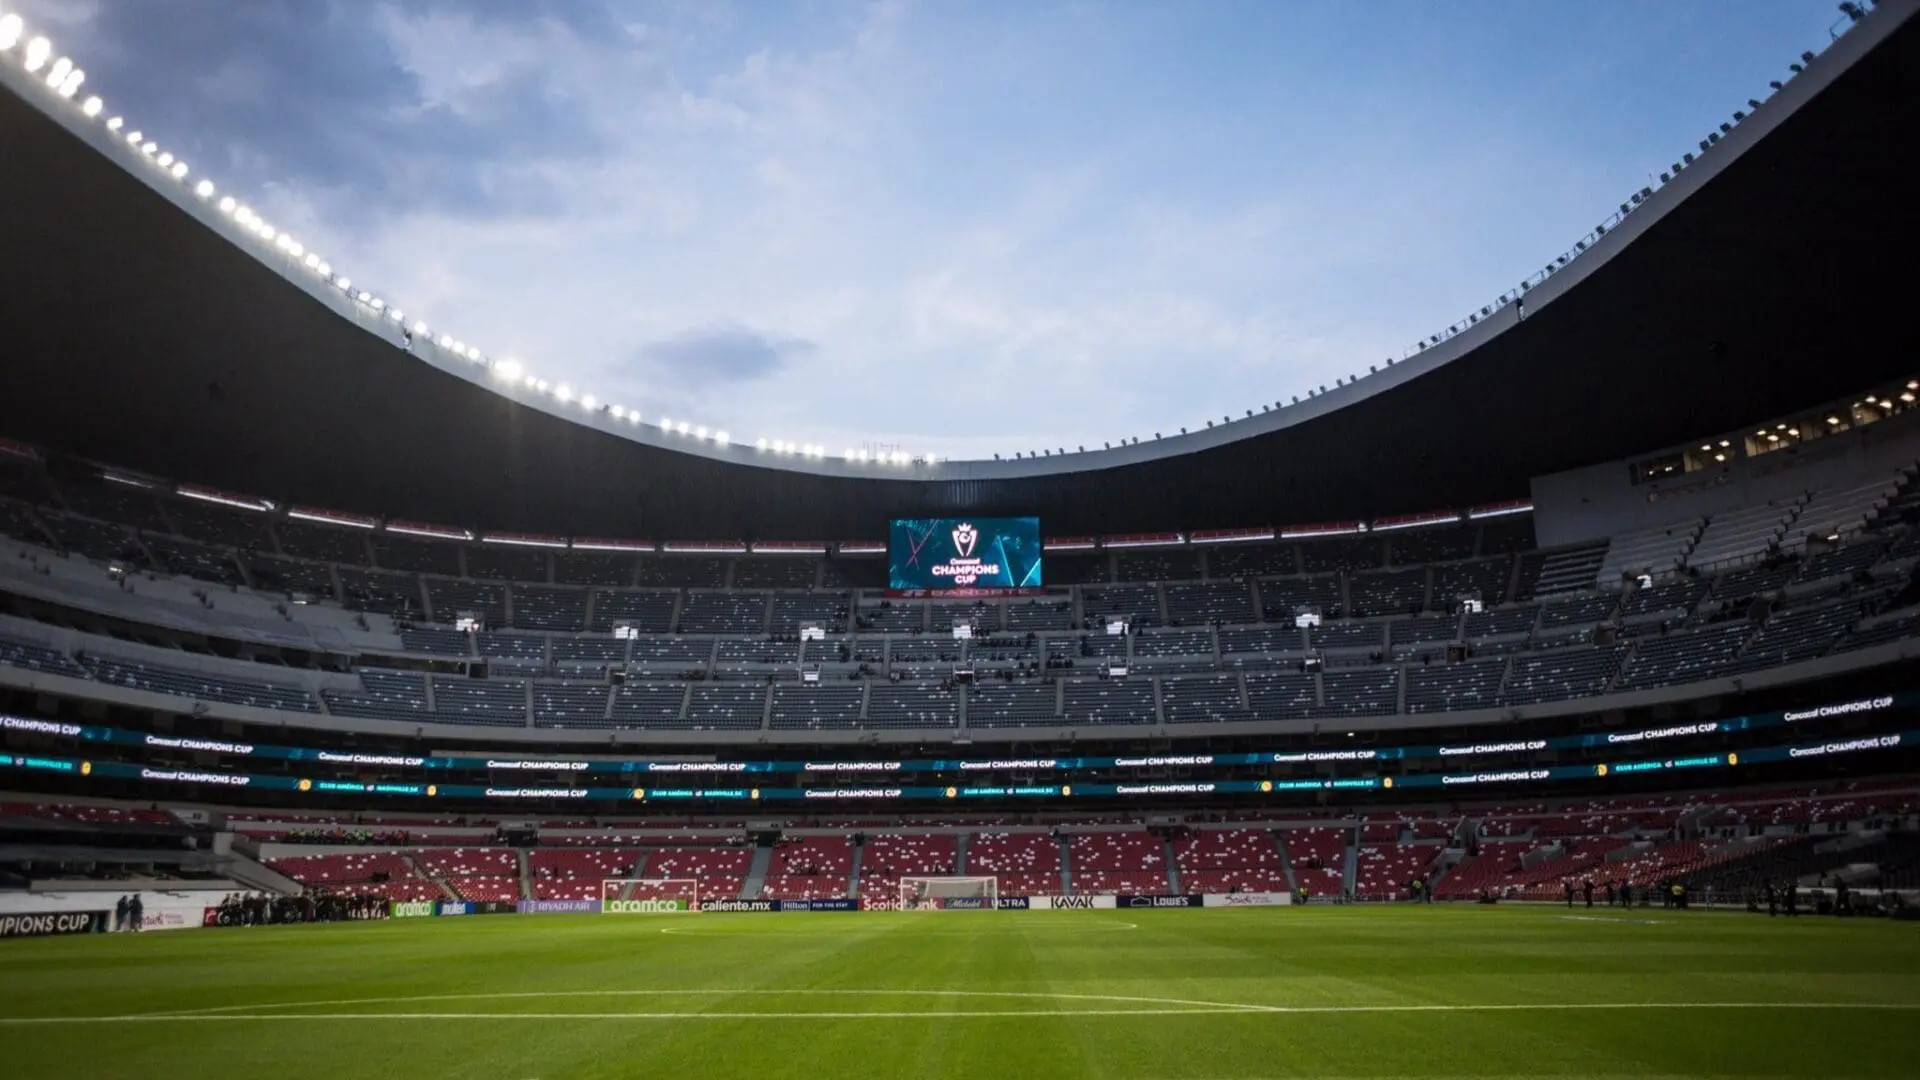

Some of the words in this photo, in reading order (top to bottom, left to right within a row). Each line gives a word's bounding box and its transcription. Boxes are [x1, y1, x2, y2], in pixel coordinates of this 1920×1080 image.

[931, 564, 999, 575] CHAMPIONS
[954, 575, 976, 584] CUP
[930, 588, 1030, 597] BANORTE
[1820, 700, 1872, 716] CHAMPIONS
[1873, 697, 1893, 708] CUP
[4, 717, 60, 733] CHAMPIONS
[62, 725, 81, 735] CUP
[1645, 725, 1697, 738] CHAMPIONS
[1698, 723, 1717, 732] CUP
[182, 740, 234, 752] CHAMPIONS
[235, 744, 253, 753] CUP
[1475, 742, 1526, 753] CHAMPIONS
[1527, 740, 1546, 749] CUP
[1826, 738, 1879, 752] CHAMPIONS
[1880, 735, 1900, 746] CUP
[354, 755, 404, 764] CHAMPIONS
[405, 757, 423, 766] CUP
[1148, 756, 1195, 765] CHAMPIONS
[1195, 756, 1213, 764] CUP
[1307, 751, 1356, 760] CHAMPIONS
[1357, 750, 1375, 759] CUP
[521, 761, 570, 770] CHAMPIONS
[571, 762, 588, 771] CUP
[682, 763, 728, 771] CHAMPIONS
[729, 763, 746, 771] CUP
[837, 762, 883, 771] CHAMPIONS
[884, 762, 900, 770] CUP
[992, 760, 1038, 769] CHAMPIONS
[1039, 759, 1056, 768] CUP
[178, 772, 229, 783] CHAMPIONS
[231, 775, 249, 784] CUP
[1478, 772, 1529, 782] CHAMPIONS
[1531, 770, 1549, 779] CUP
[521, 788, 569, 797] CHAMPIONS
[571, 789, 587, 798] CUP
[838, 789, 883, 798] CHAMPIONS
[885, 789, 901, 797] CUP
[1149, 784, 1196, 793] CHAMPIONS
[1197, 783, 1214, 792] CUP
[538, 903, 573, 911] RIYADH
[574, 903, 590, 911] AIR
[611, 899, 677, 912] aramco
[701, 899, 770, 911] caliente.mx
[783, 901, 808, 909] Hilton
[991, 899, 1026, 908] ULTRA
[1051, 896, 1094, 908] KAVAK
[1153, 896, 1188, 907] LOWE'S
[395, 902, 431, 917] aramco
[58, 914, 89, 931] CUP
